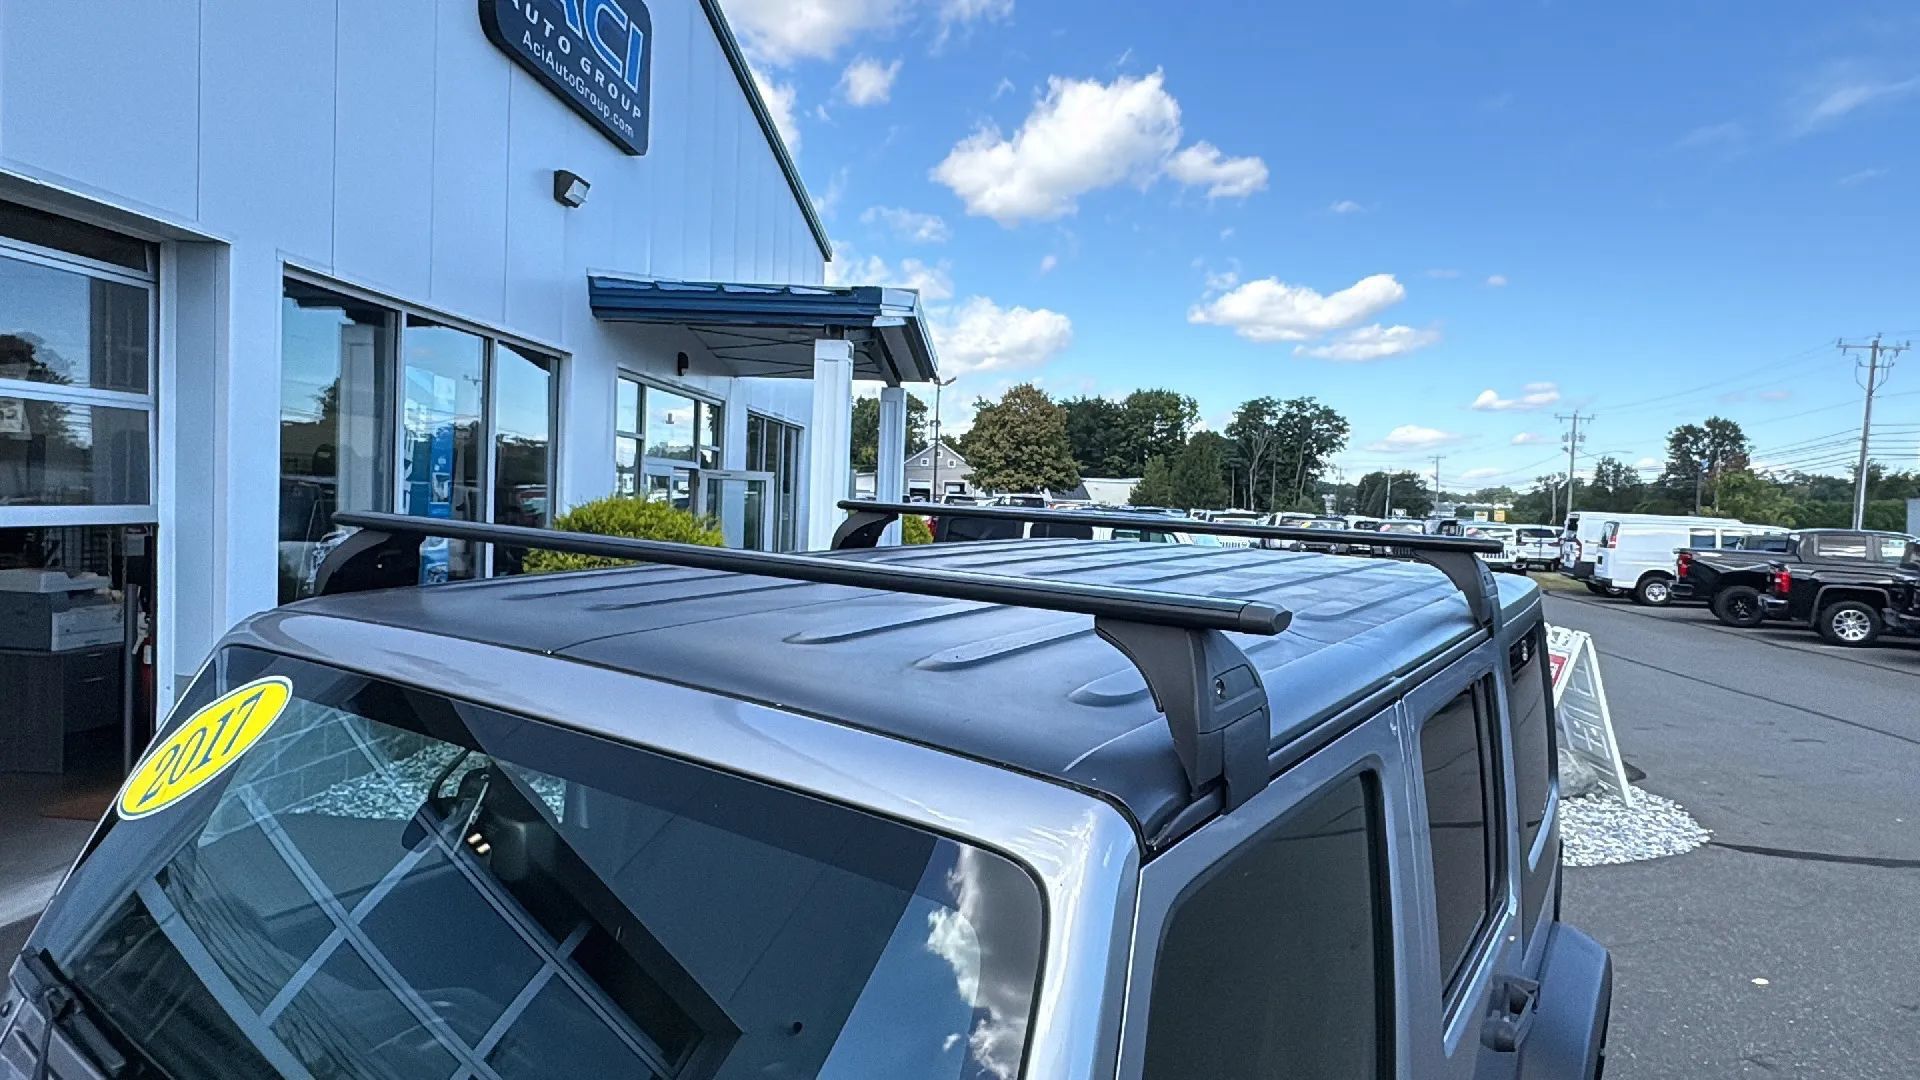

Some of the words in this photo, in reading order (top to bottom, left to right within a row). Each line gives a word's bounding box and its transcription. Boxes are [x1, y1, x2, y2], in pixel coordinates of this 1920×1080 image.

[523, 30, 634, 138] AciAutoGroup.com
[580, 57, 641, 118] GROUP
[136, 688, 266, 808] 2017
